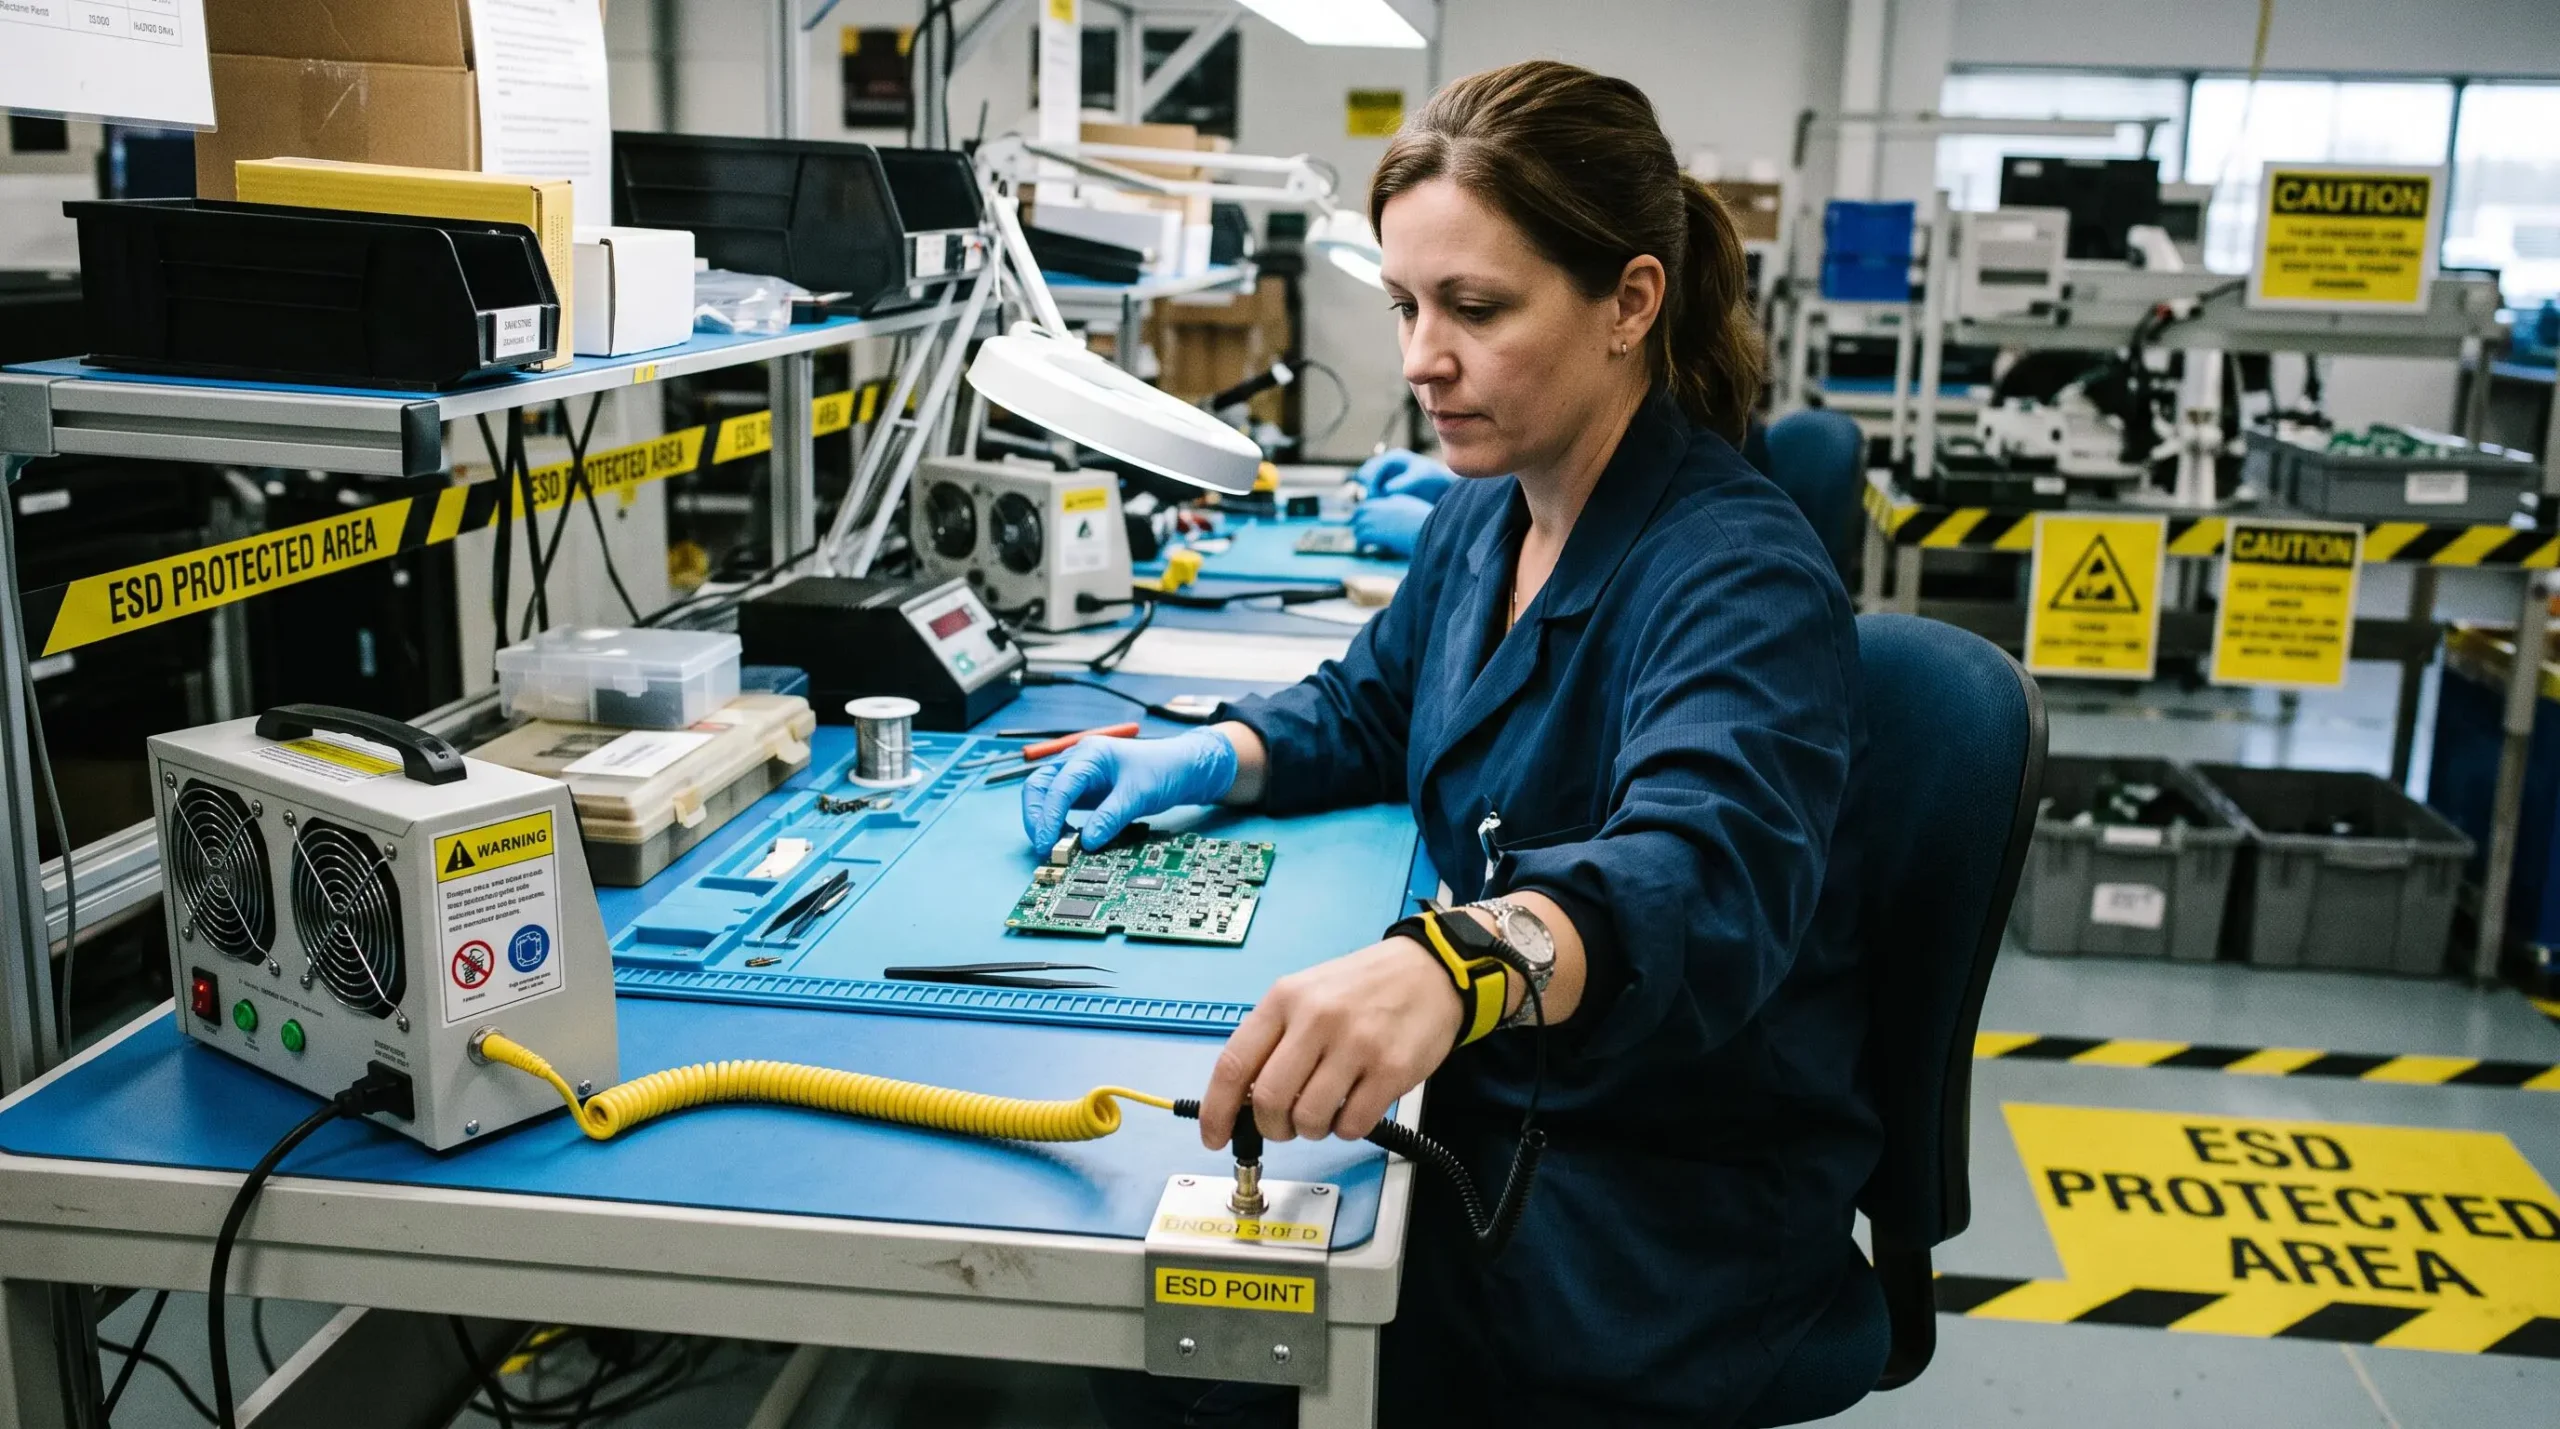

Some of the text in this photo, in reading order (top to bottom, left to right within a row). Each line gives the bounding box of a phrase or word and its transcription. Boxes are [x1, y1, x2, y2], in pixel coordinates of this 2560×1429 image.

[2278, 180, 2423, 213] CAUTION
[531, 439, 684, 505] ESD POTECTED AREA
[2235, 531, 2350, 563] CAUTION
[108, 517, 377, 624] ESD PROTECTED AREA
[477, 829, 547, 858] WARNING
[2182, 1126, 2353, 1172] ESD
[2044, 1167, 2560, 1243] PROTECTED
[1165, 1275, 1305, 1304] ESD POINT
[2229, 1236, 2488, 1298] AREA
